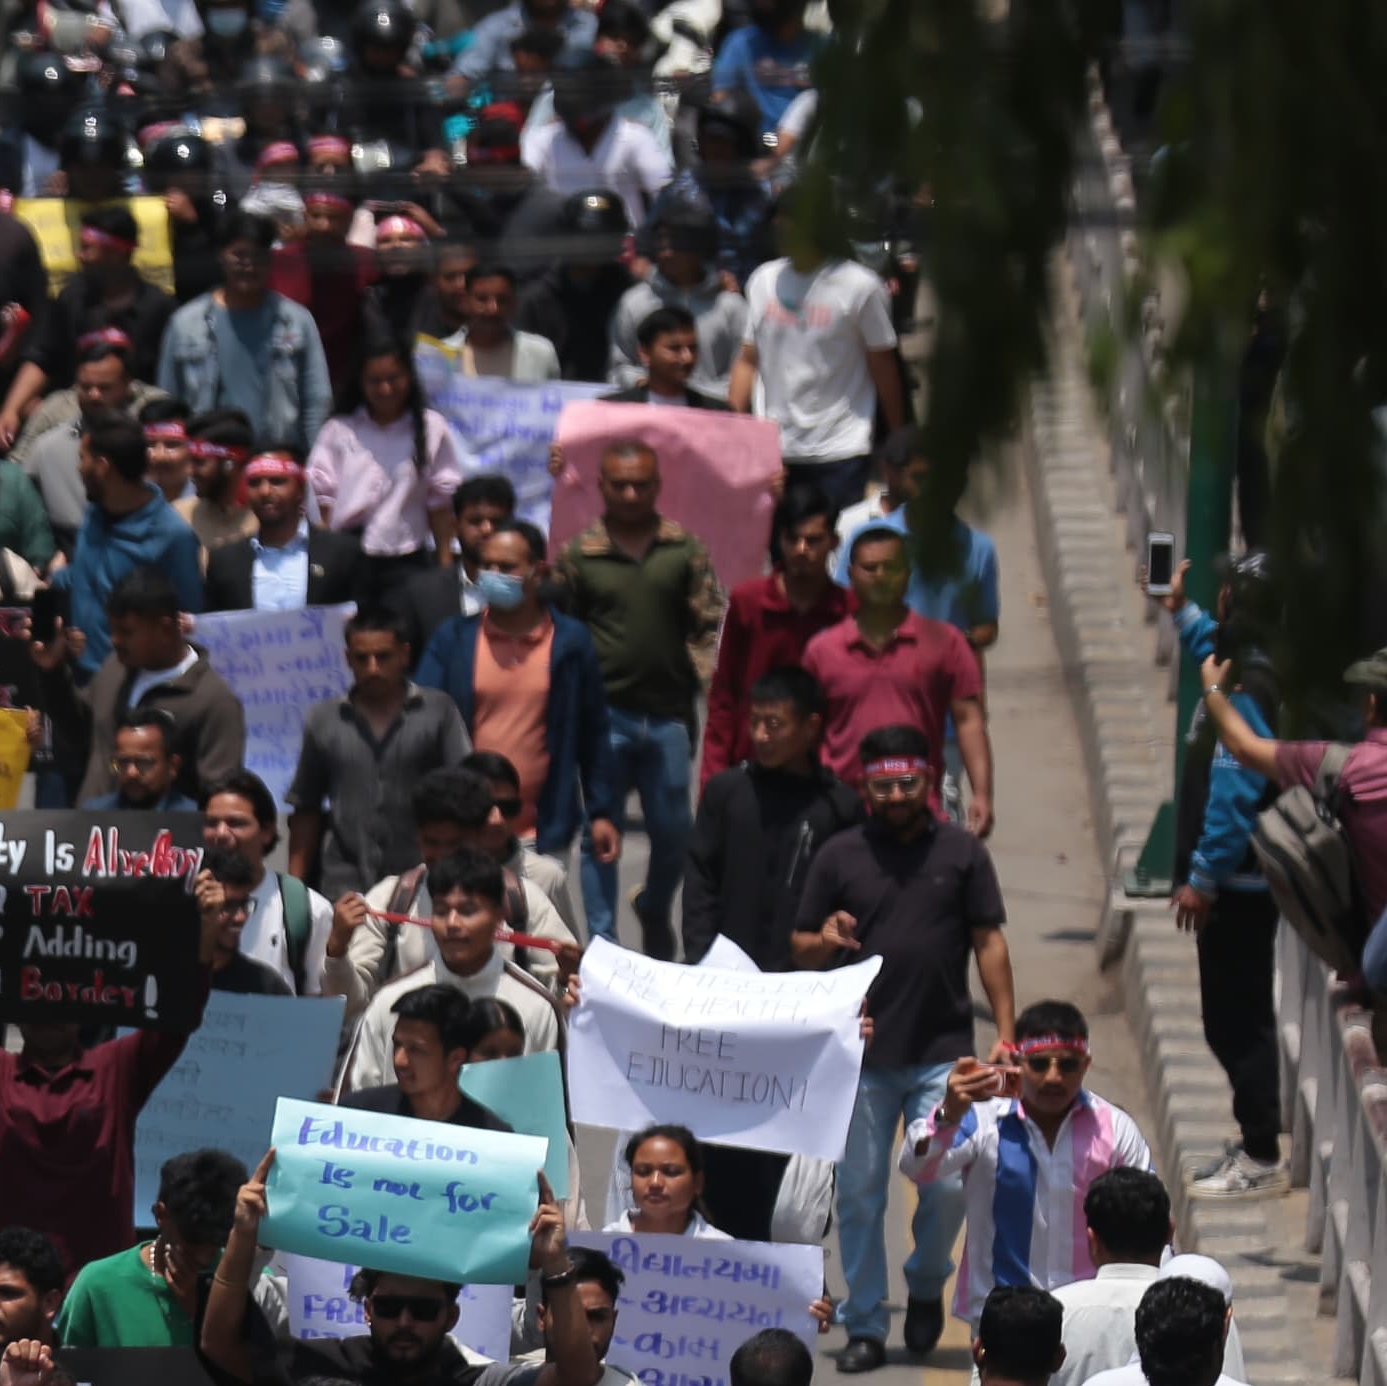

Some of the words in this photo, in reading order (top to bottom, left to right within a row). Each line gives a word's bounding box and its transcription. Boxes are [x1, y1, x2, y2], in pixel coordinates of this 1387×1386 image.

[44, 829, 76, 876] Is
[23, 884, 97, 918] TAX
[23, 924, 139, 970] Adding
[674, 971, 839, 997] MISSION
[660, 1022, 738, 1061] FREE
[297, 1116, 479, 1165] Education
[372, 1176, 426, 1200] not
[440, 1180, 500, 1214] for
[316, 1203, 413, 1244] Sale
